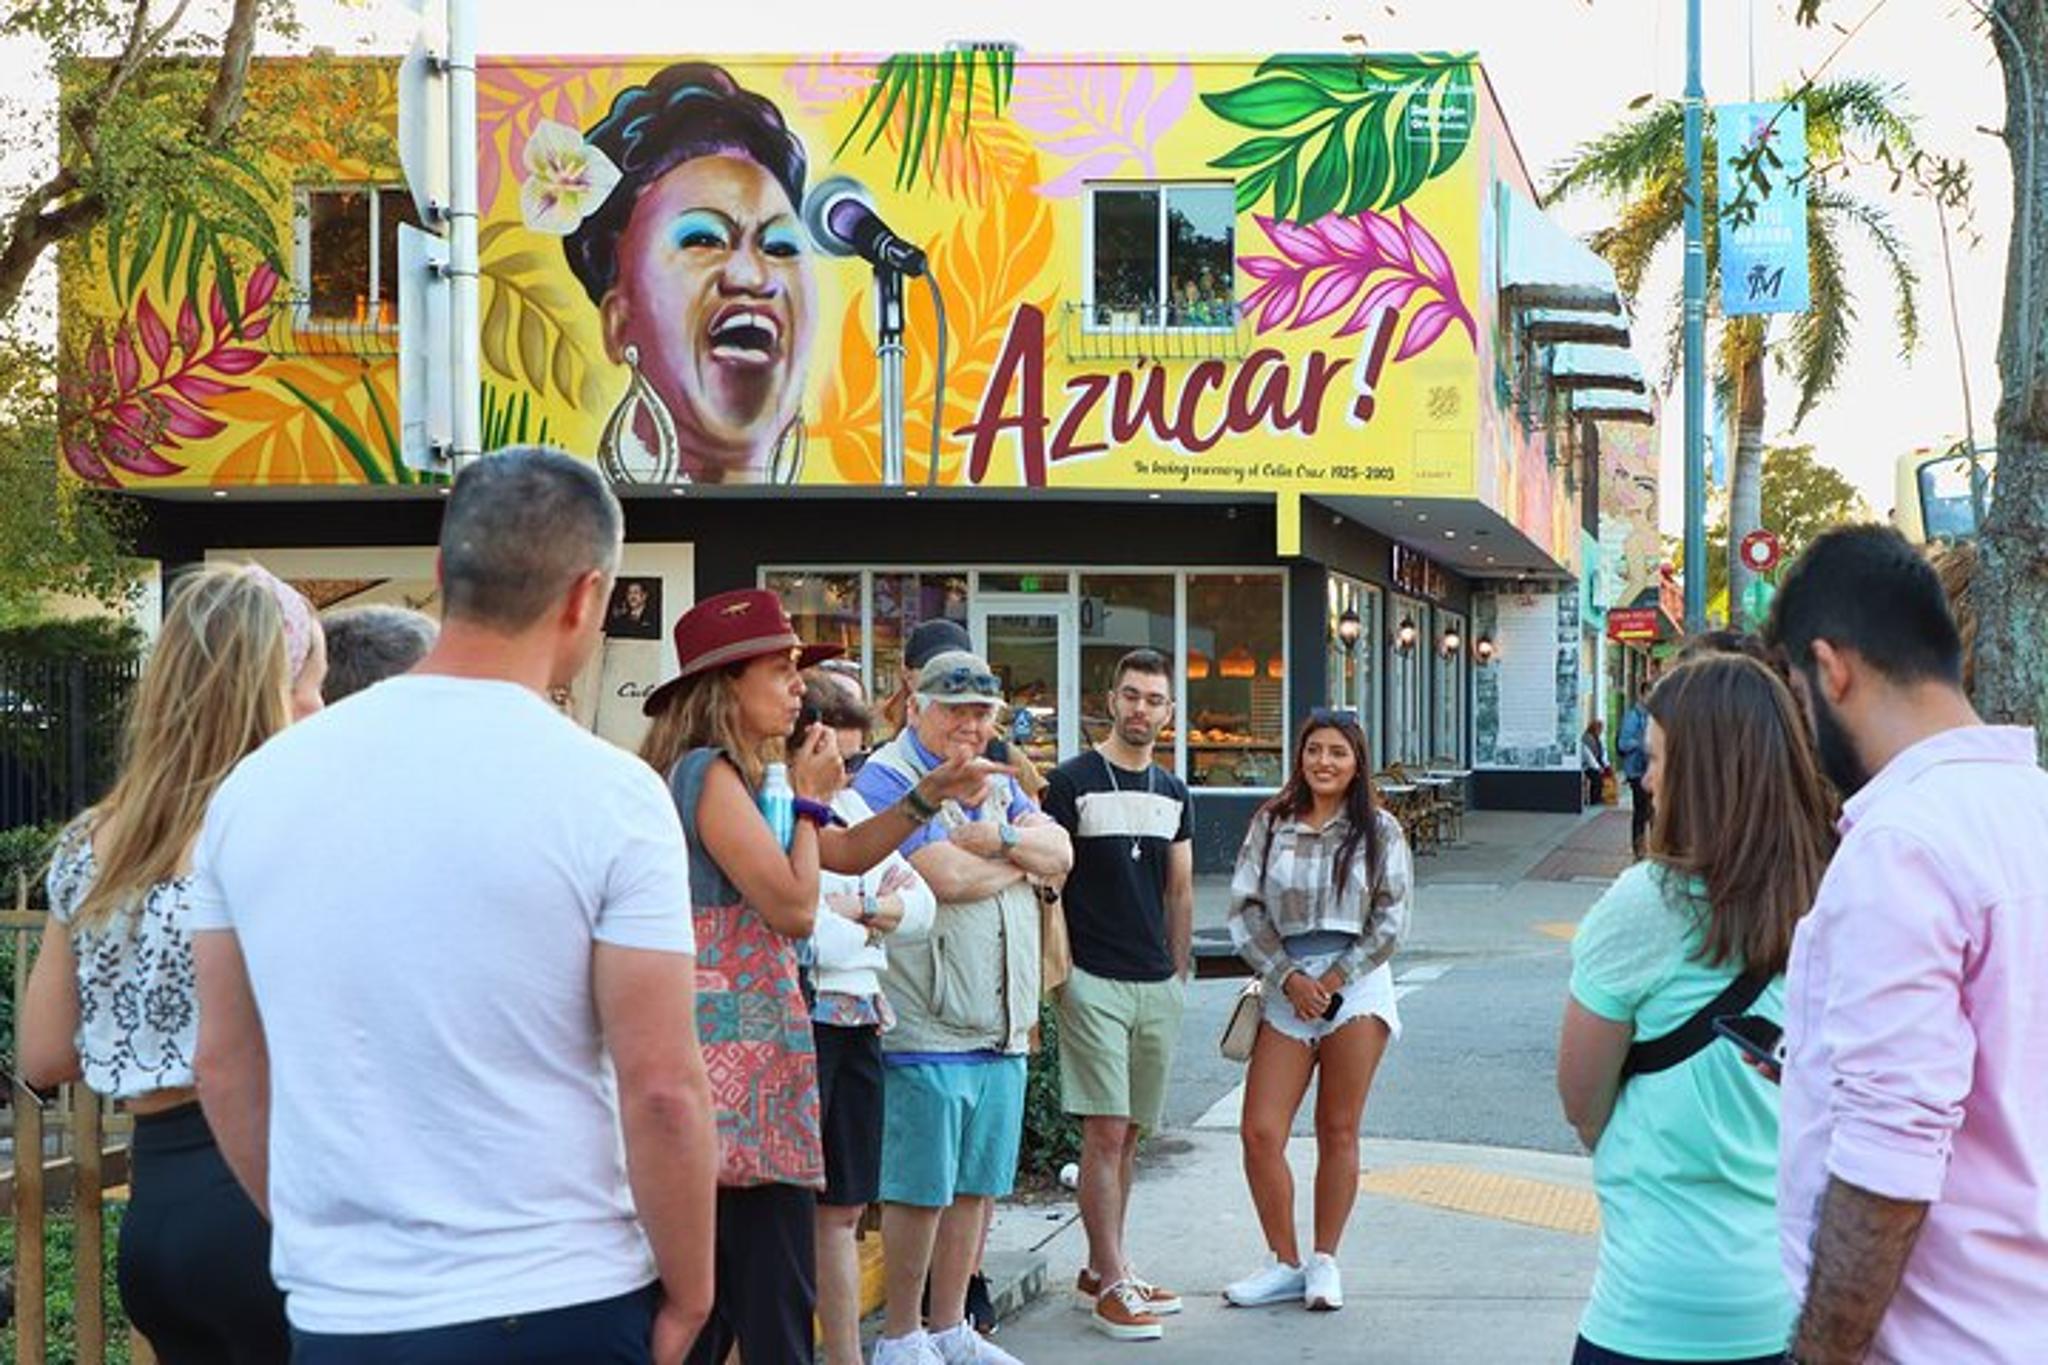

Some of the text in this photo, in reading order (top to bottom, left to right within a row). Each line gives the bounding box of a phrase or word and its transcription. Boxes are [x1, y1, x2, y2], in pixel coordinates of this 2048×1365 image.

[953, 303, 1399, 487] Azúcar!
[1191, 464, 1244, 483] memory
[1262, 462, 1292, 476] Celia
